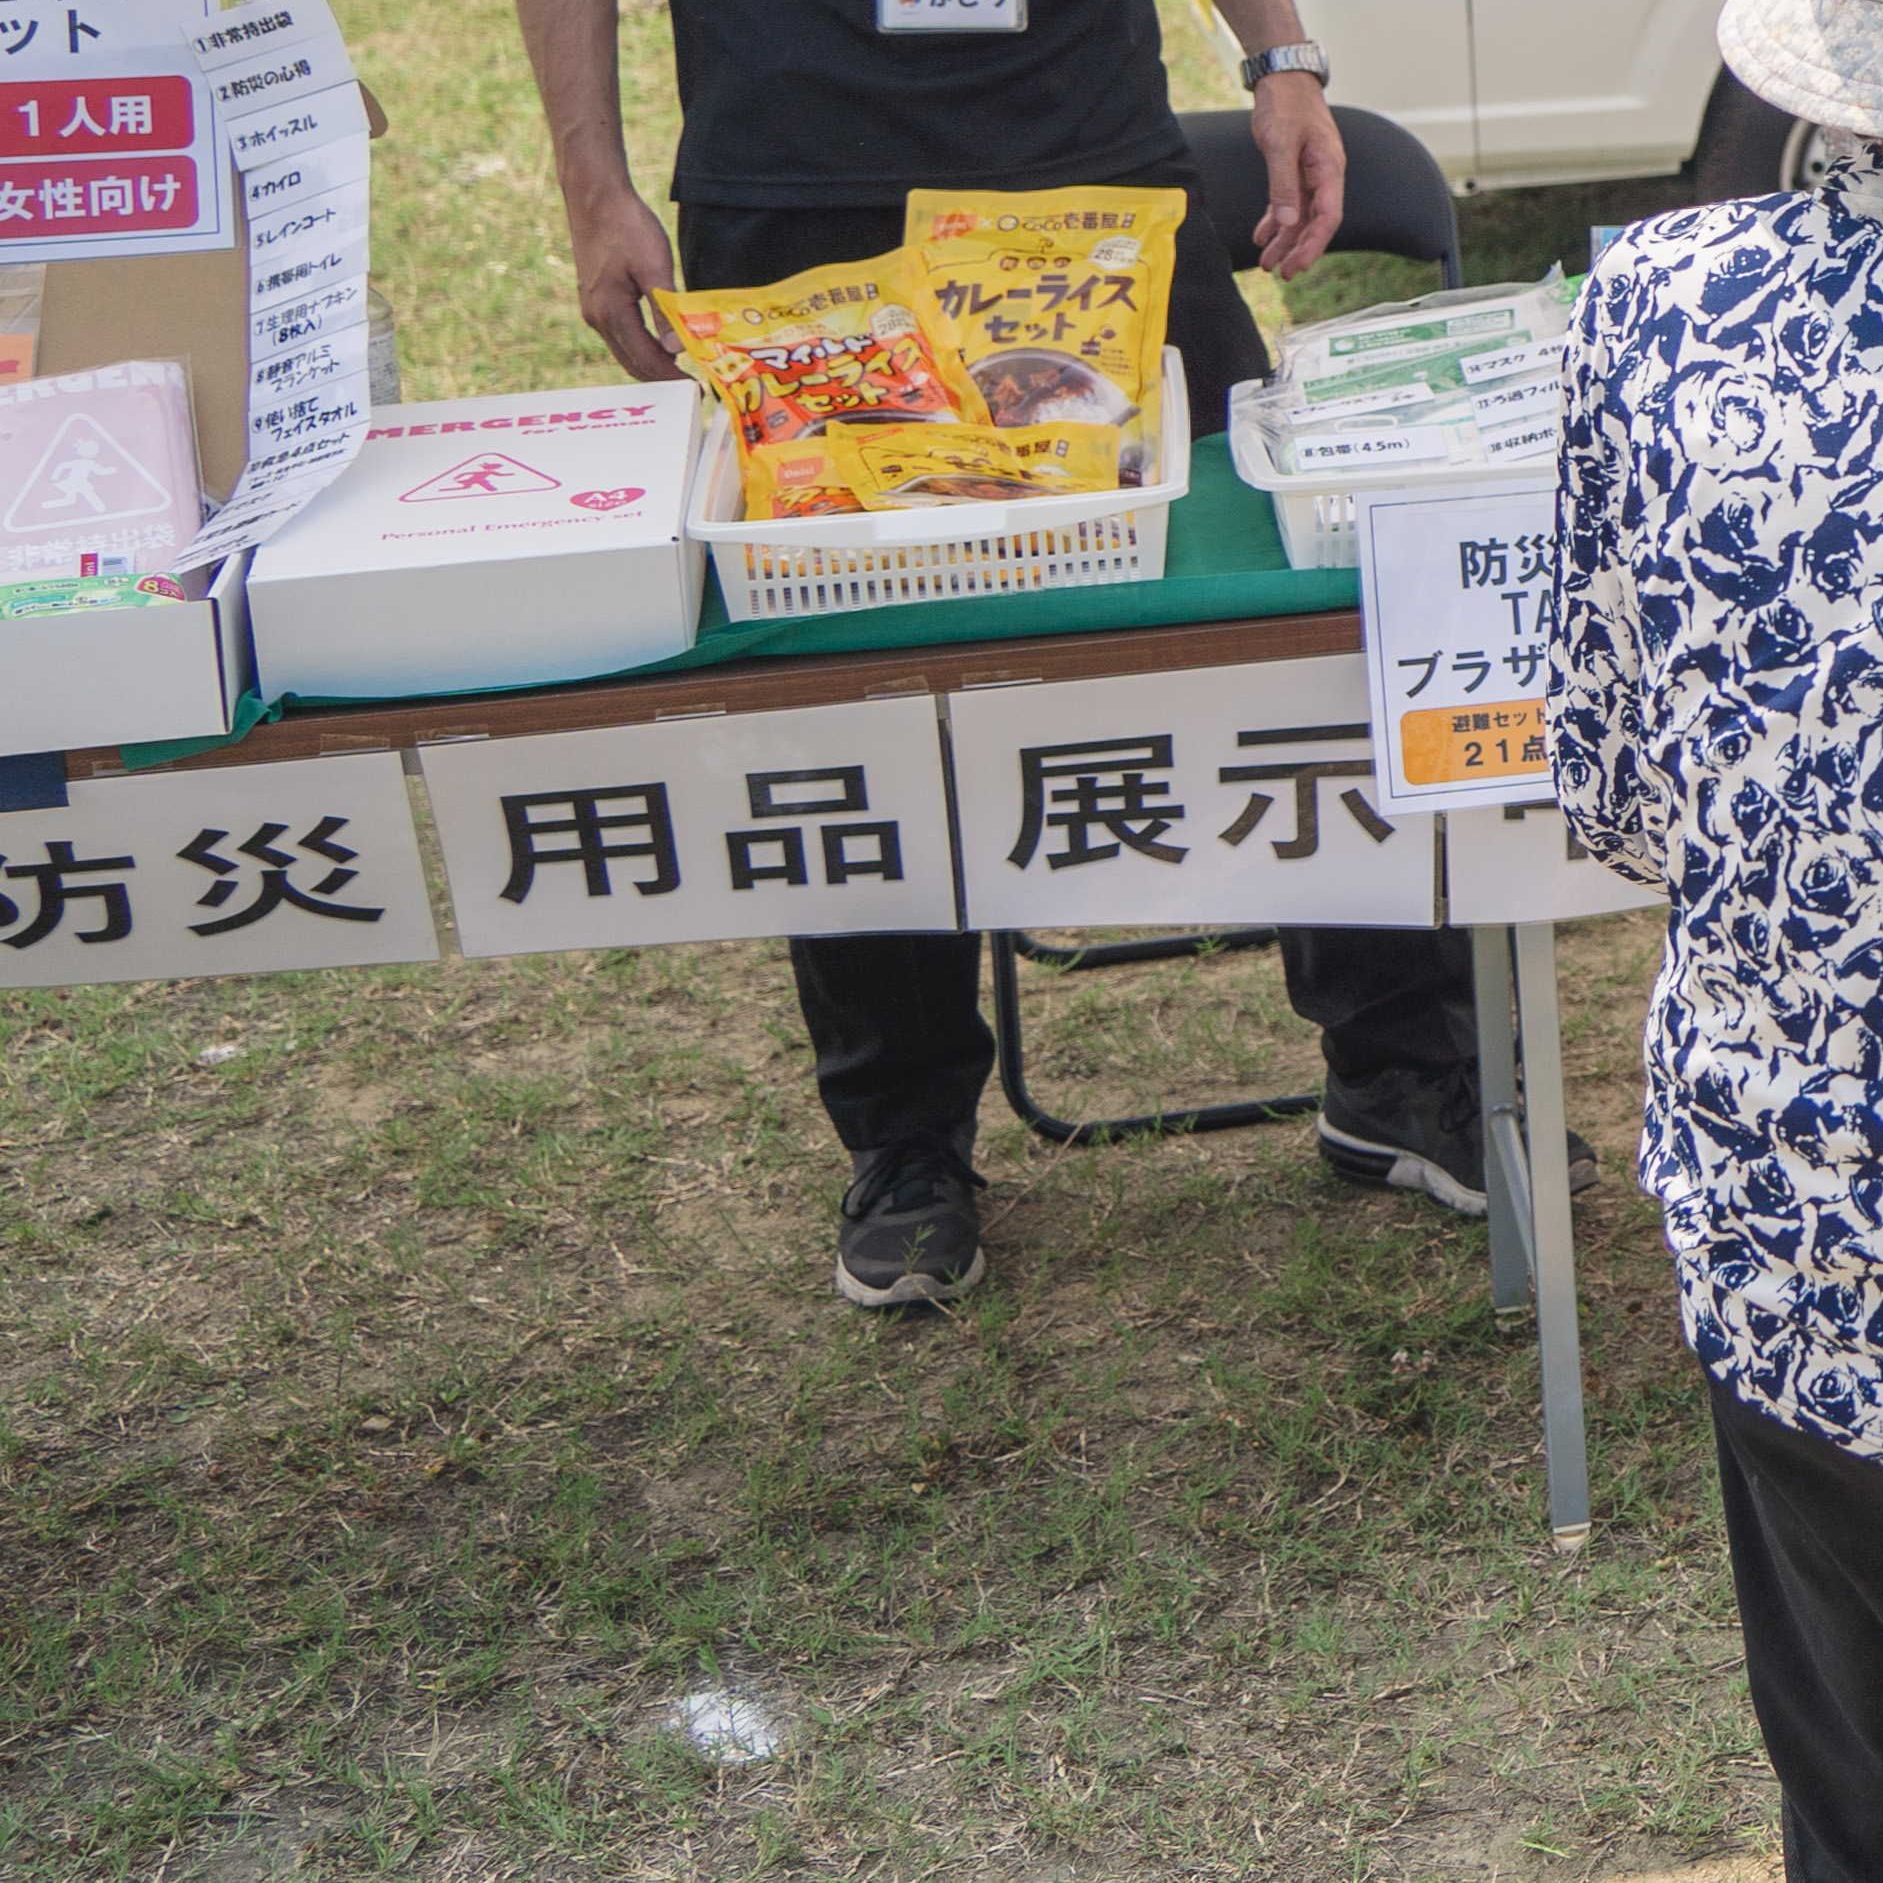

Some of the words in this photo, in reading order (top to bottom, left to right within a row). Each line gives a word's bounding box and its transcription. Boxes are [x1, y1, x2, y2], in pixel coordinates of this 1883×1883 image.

[0, 173, 181, 220] 女性向け
[935, 275, 1138, 320] カレーライス
[985, 313, 1076, 344] セット
[795, 380, 890, 414] セット
[584, 490, 629, 505] A4
[380, 525, 476, 542] Personal
[484, 513, 605, 533] Emergency
[612, 510, 643, 520] set
